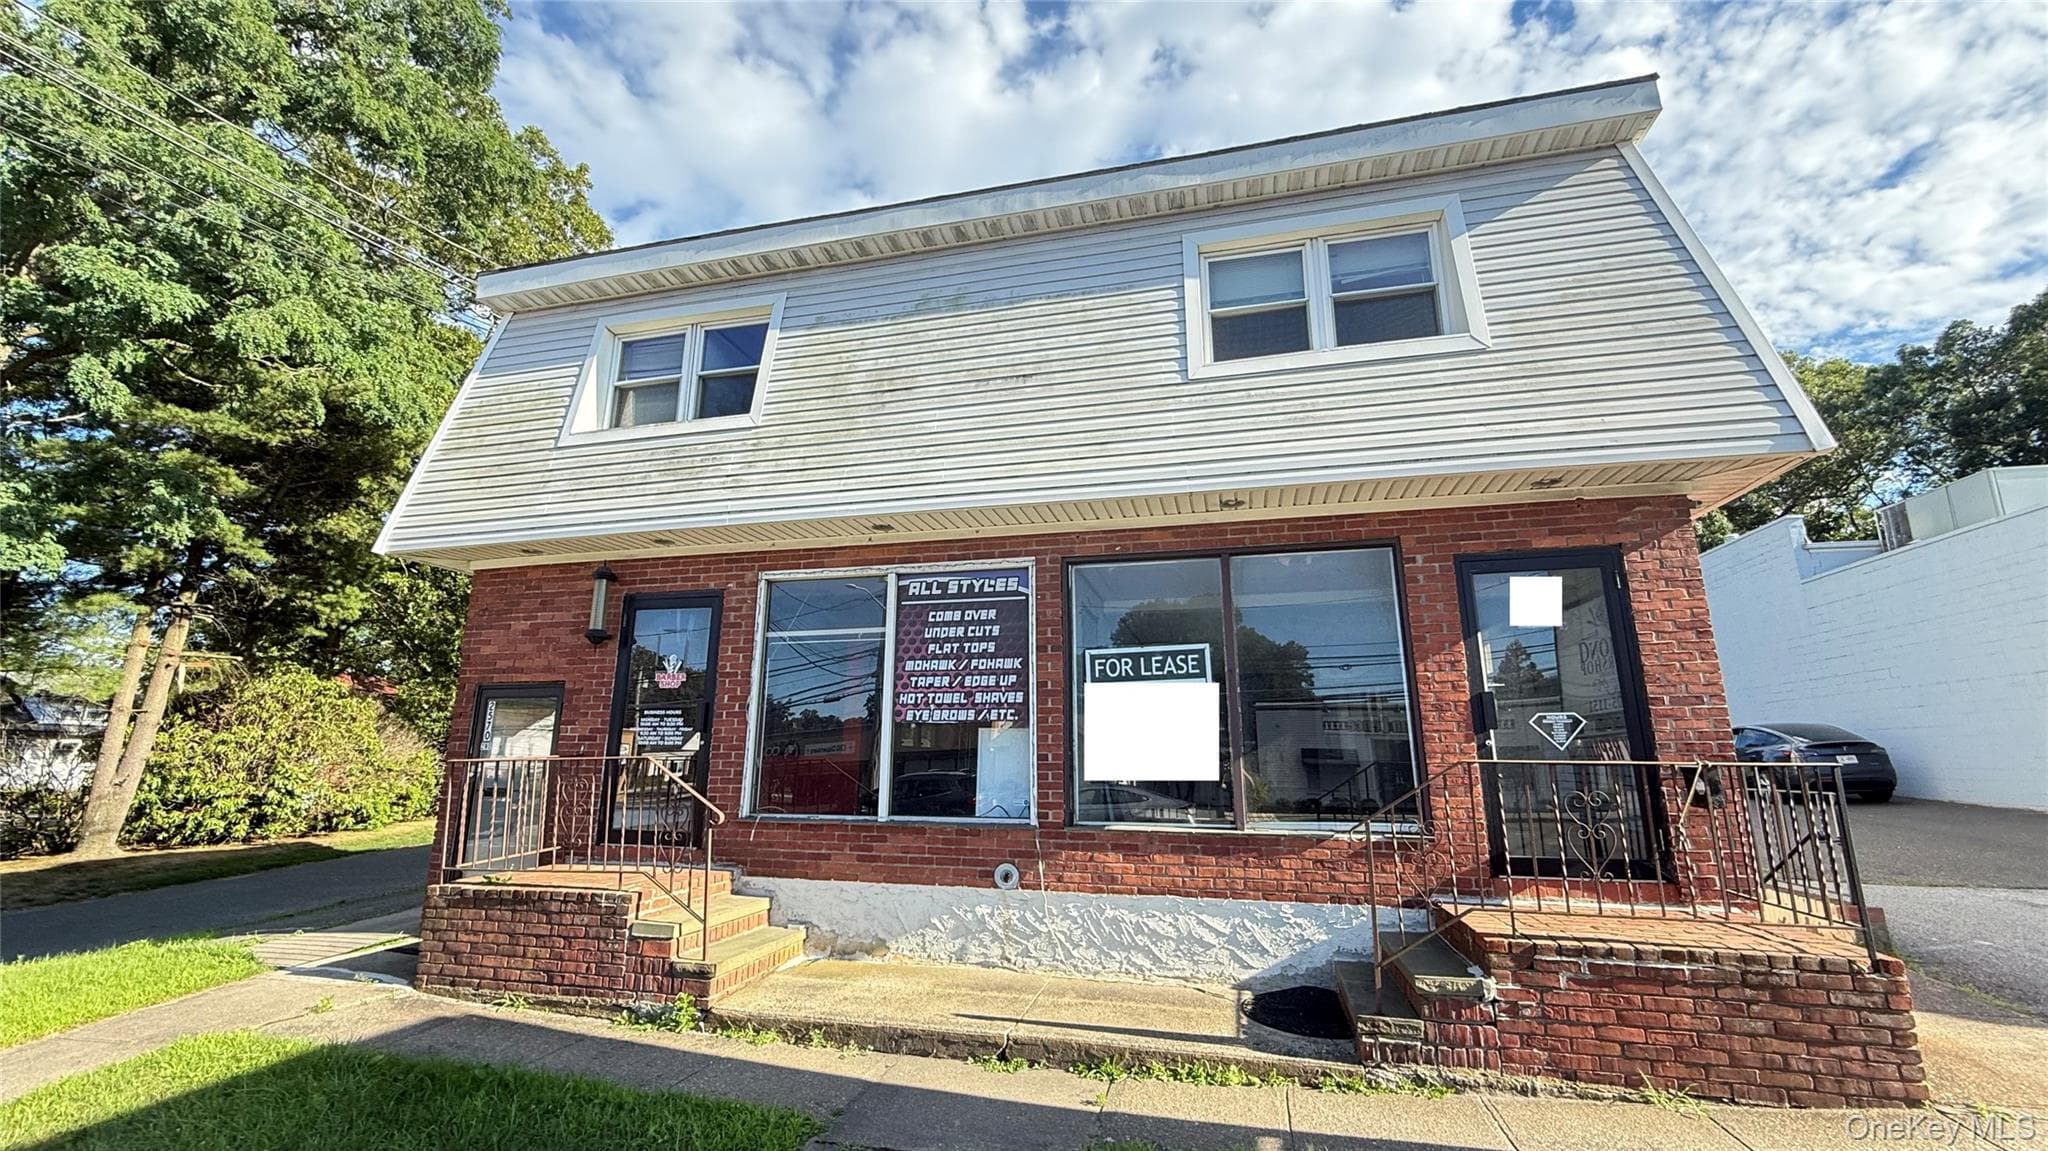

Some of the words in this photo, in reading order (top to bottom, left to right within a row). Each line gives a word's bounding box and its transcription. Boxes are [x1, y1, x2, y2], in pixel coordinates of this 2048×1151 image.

[908, 581, 942, 595] ALL
[947, 577, 1019, 594] STYLES
[928, 610, 962, 622] COMB
[964, 609, 997, 620] OVER
[924, 626, 965, 638] UNDER
[968, 625, 1000, 637] CUTS
[928, 643, 960, 654] FLAT
[963, 642, 996, 653] TOPS
[905, 659, 958, 671] MOHAWK
[958, 659, 969, 670] /
[970, 658, 1024, 670] FOHAWK
[1095, 658, 1134, 678] FOR
[1140, 655, 1200, 676] LEASE
[656, 672, 685, 681] BARBER
[910, 676, 950, 687] TAPER
[952, 675, 962, 687] /
[964, 675, 996, 686] EDGE
[999, 674, 1017, 686] UP
[899, 693, 924, 704] HOT
[927, 692, 968, 704] TOWEL
[974, 691, 1024, 703] SHAVES
[484, 701, 496, 740] 2570
[990, 709, 1018, 721] ETC.
